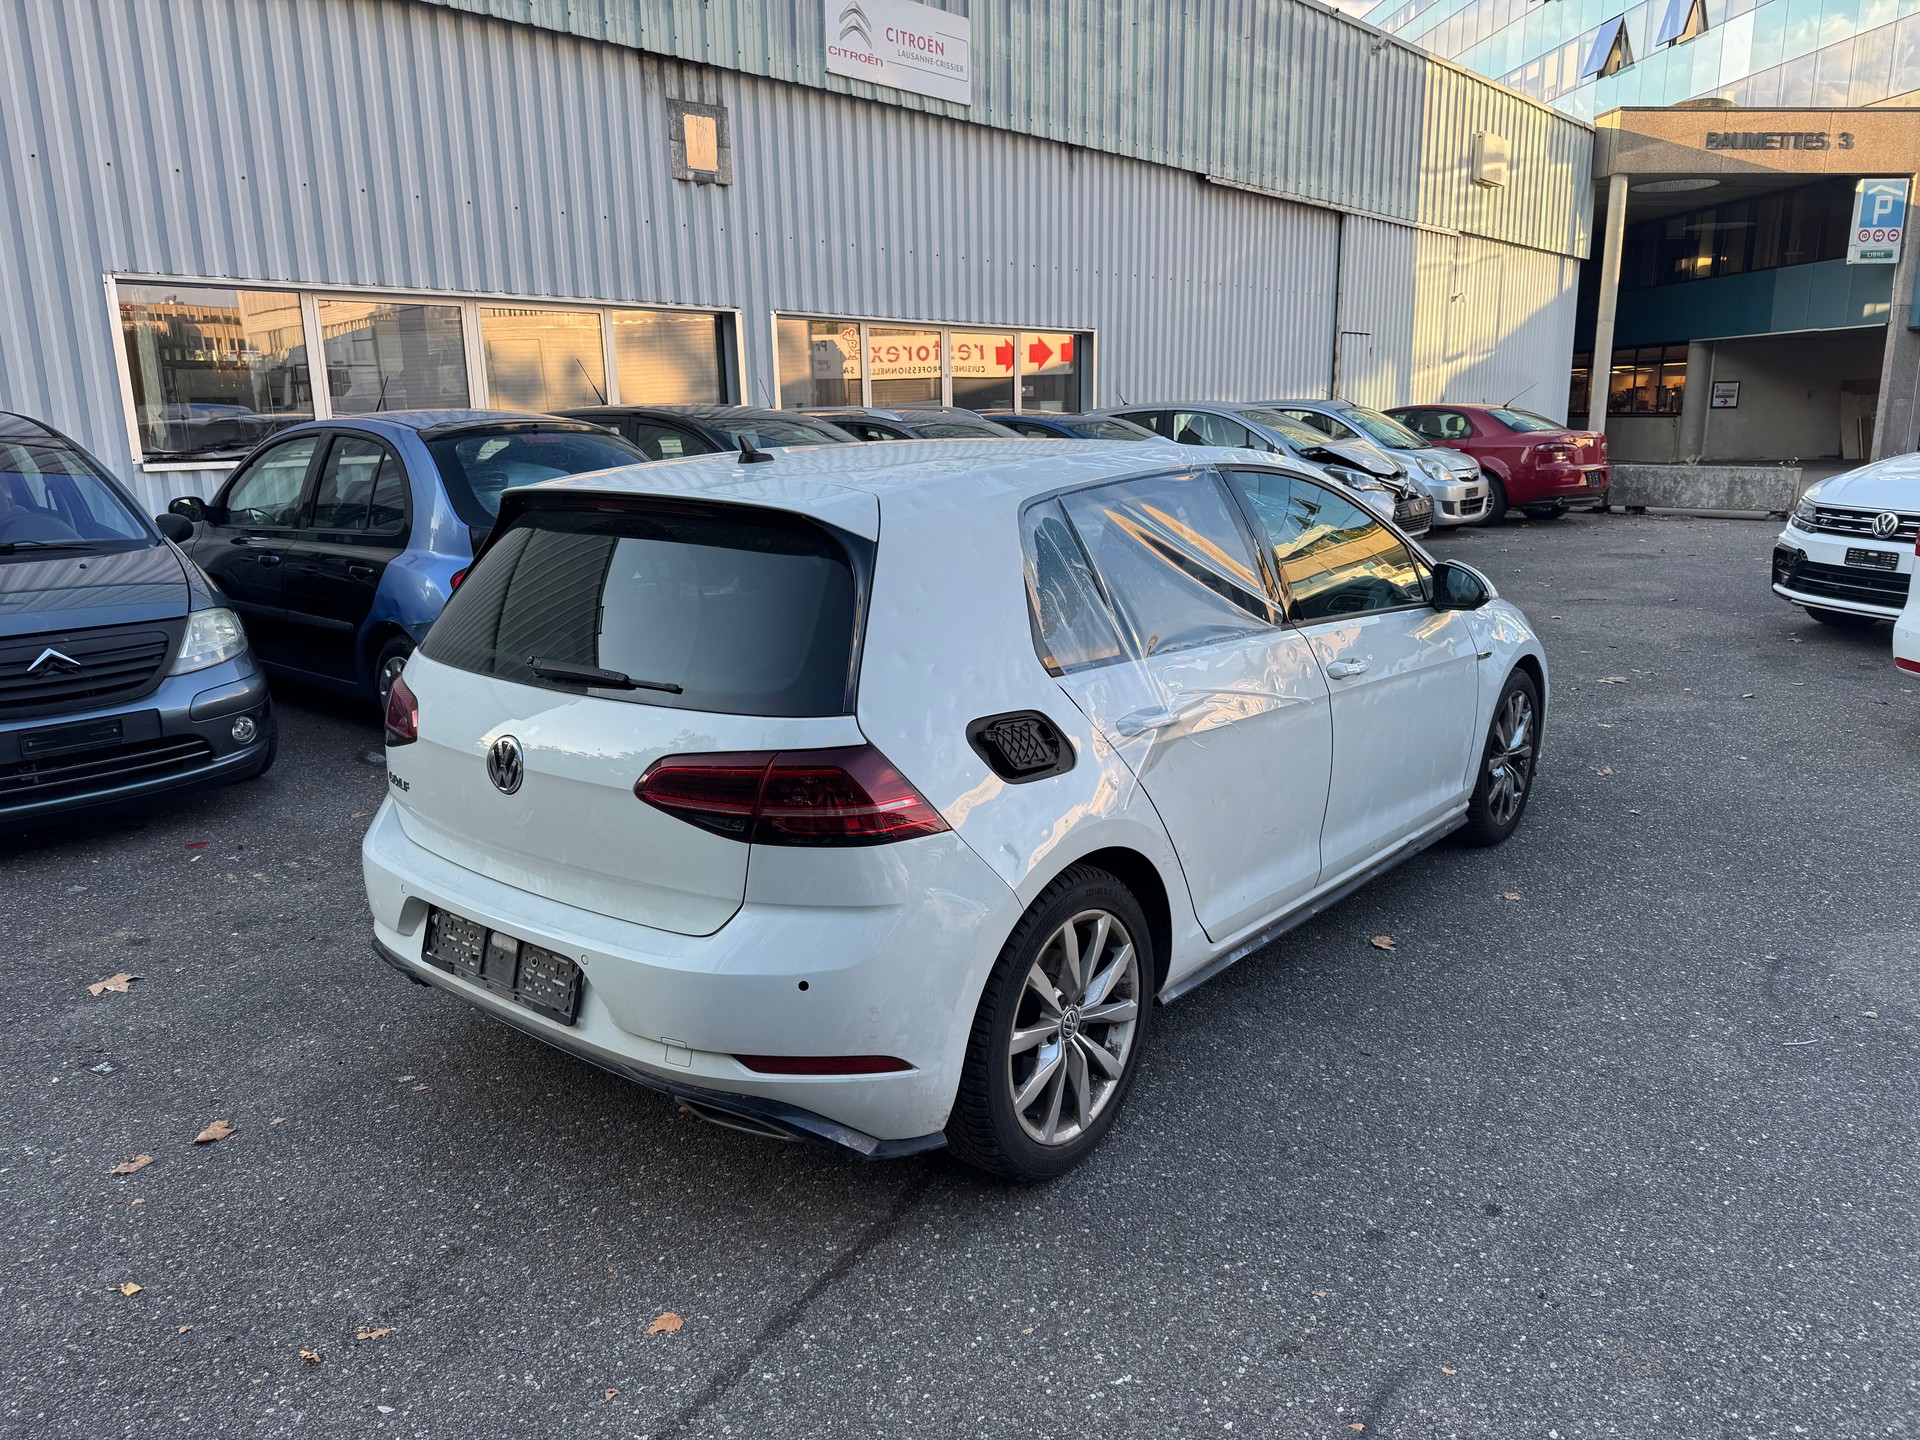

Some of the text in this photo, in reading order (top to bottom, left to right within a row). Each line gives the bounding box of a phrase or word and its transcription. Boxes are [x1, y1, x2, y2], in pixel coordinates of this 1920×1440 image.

[886, 27, 945, 56] CITROËN
[828, 45, 884, 67] CITROËN
[897, 48, 964, 73] LAUSANNE-CRISSIER
[1706, 131, 1855, 150] BAUMETTES 3
[1872, 195, 1893, 225] P
[388, 771, 410, 793] GOLF
